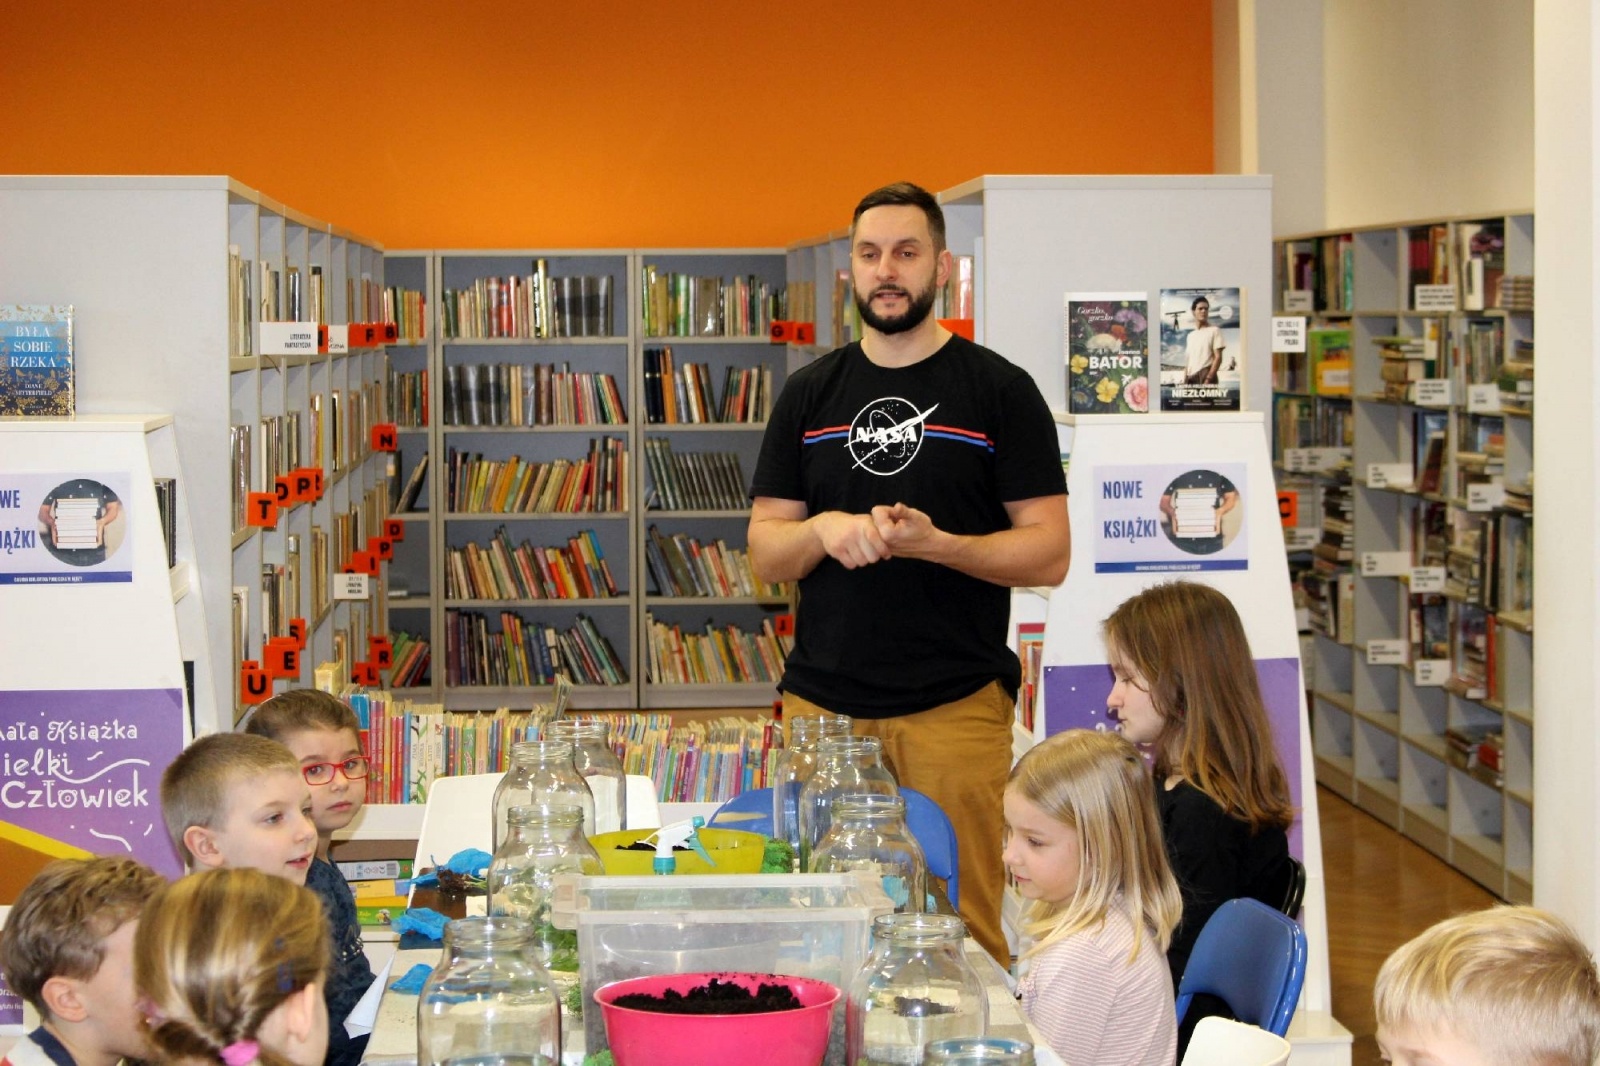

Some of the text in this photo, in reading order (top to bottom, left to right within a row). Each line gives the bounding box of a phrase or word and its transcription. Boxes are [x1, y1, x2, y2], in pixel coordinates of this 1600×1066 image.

[16, 325, 50, 337] BYŁA
[366, 328, 374, 342] F
[13, 341, 53, 353] SOBIE
[10, 356, 57, 368] RZEKA
[1089, 356, 1143, 369] BATOR
[1171, 389, 1229, 398] NIEZŁOMNY
[380, 433, 393, 447] N
[856, 426, 918, 443] NASA
[297, 477, 310, 495] P
[1103, 481, 1143, 499] NOWE
[258, 499, 272, 519] T
[1103, 516, 1157, 544] KSIĄŻKI
[379, 541, 390, 555] P
[283, 651, 296, 670] E
[379, 651, 389, 664] R
[367, 667, 375, 681] L
[247, 674, 267, 695] U
[46, 718, 138, 745] Książka
[1, 769, 149, 809] Człowiek
